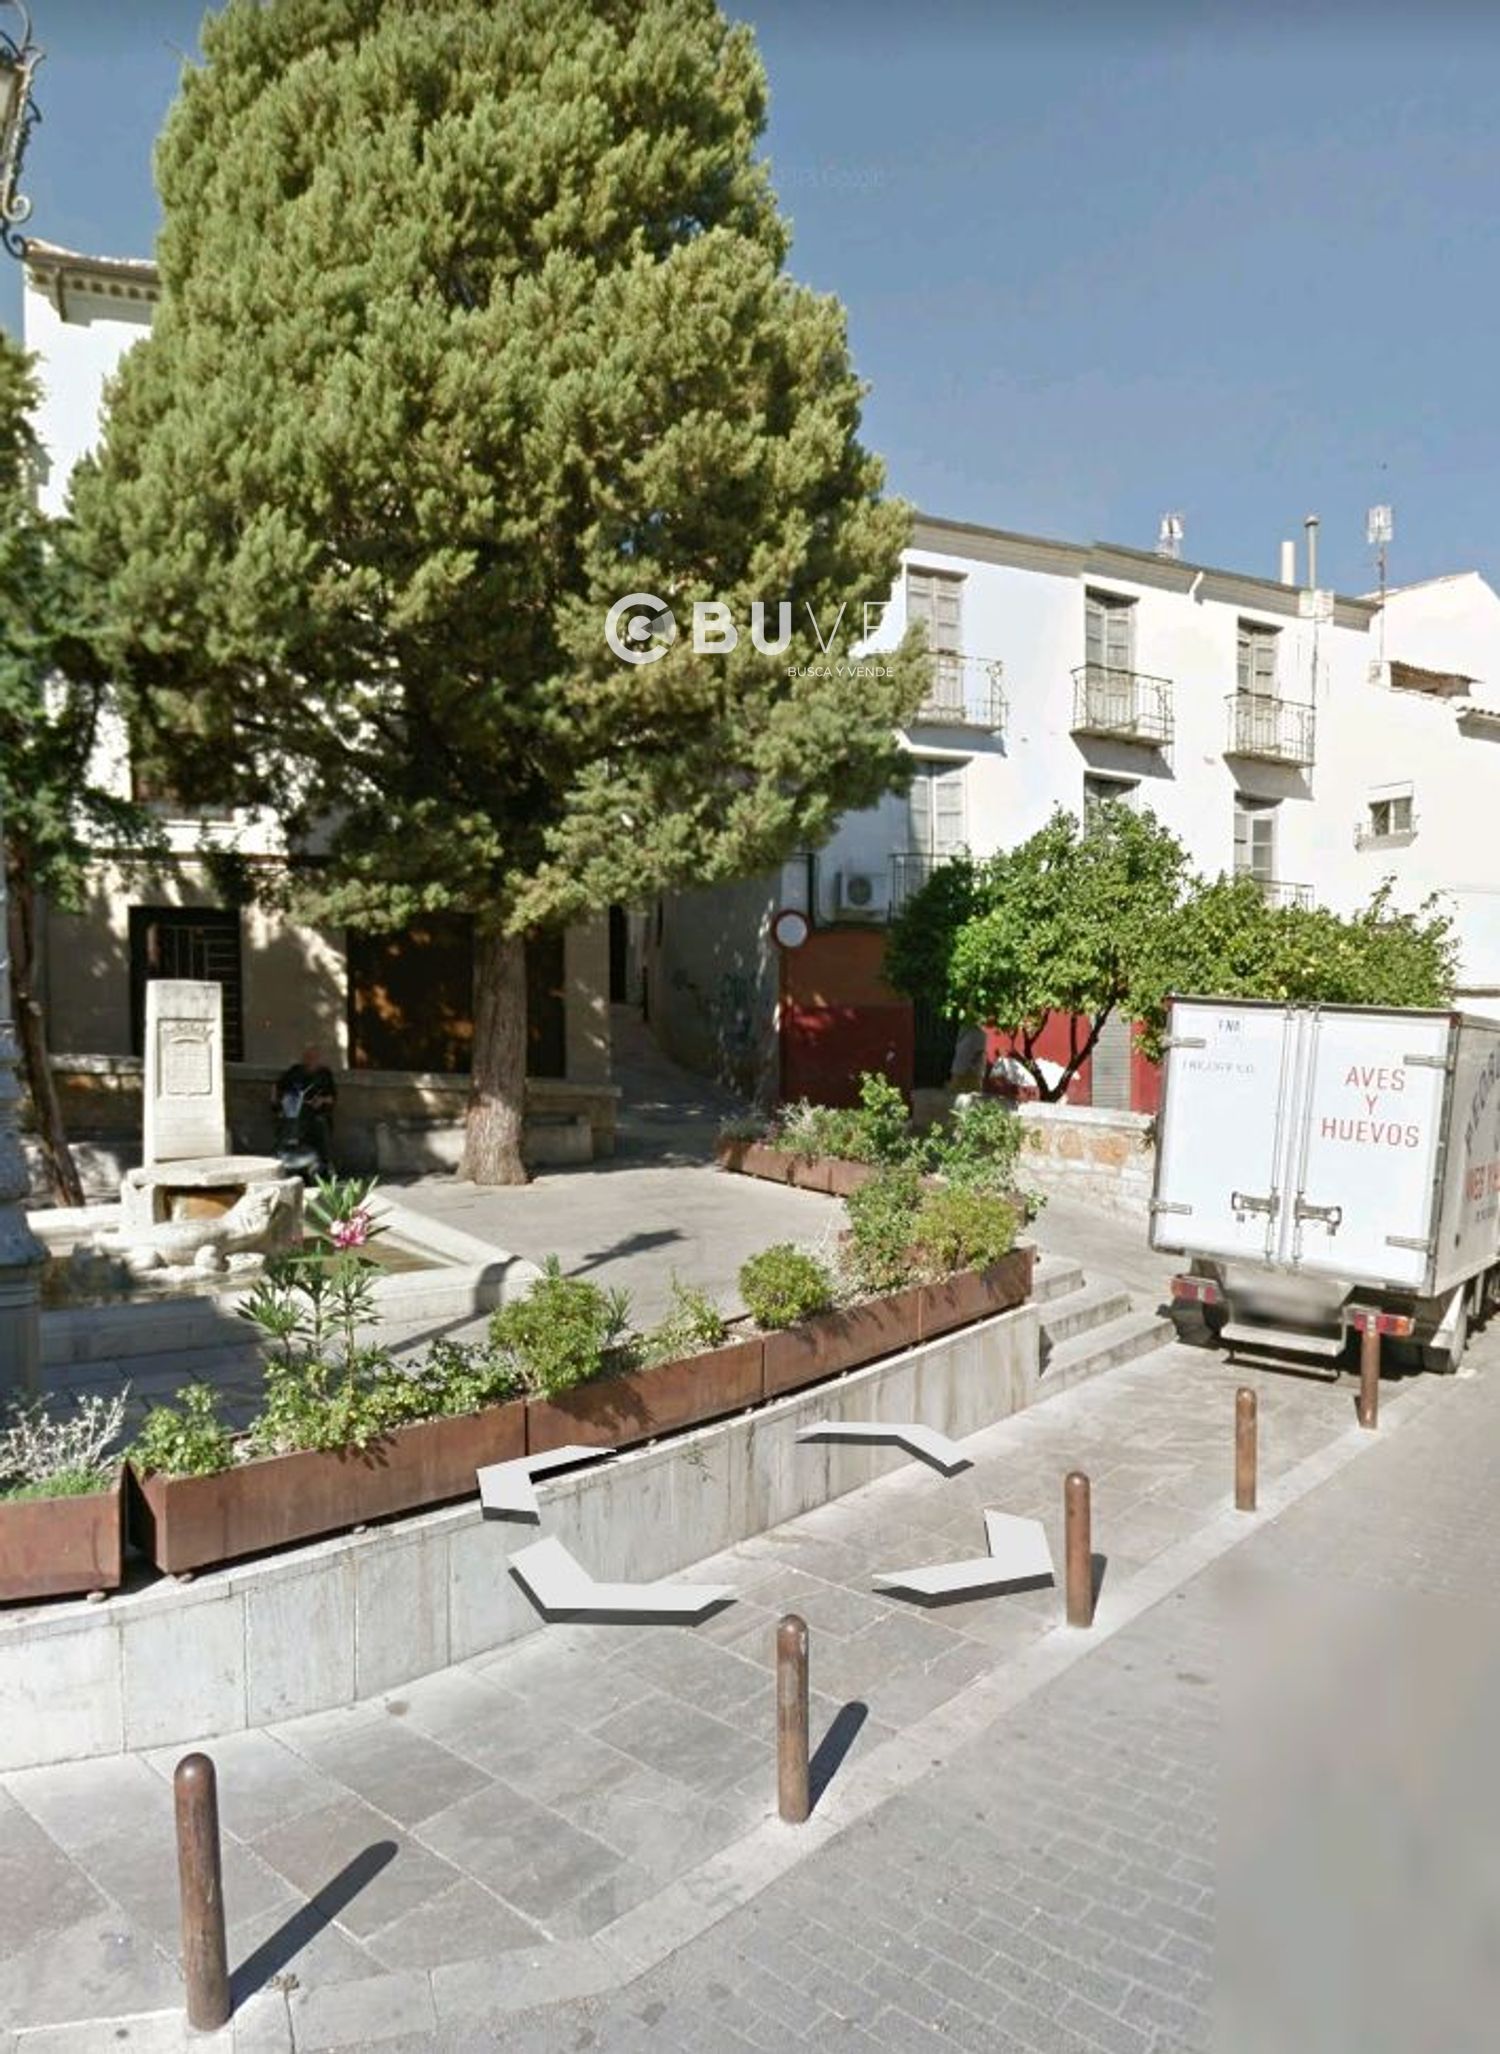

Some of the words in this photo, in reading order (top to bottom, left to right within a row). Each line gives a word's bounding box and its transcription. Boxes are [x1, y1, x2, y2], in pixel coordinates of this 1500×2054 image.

[1344, 1066, 1406, 1091] AVES
[1365, 1094, 1379, 1115] Y
[1321, 1117, 1420, 1148] HUEVOS
